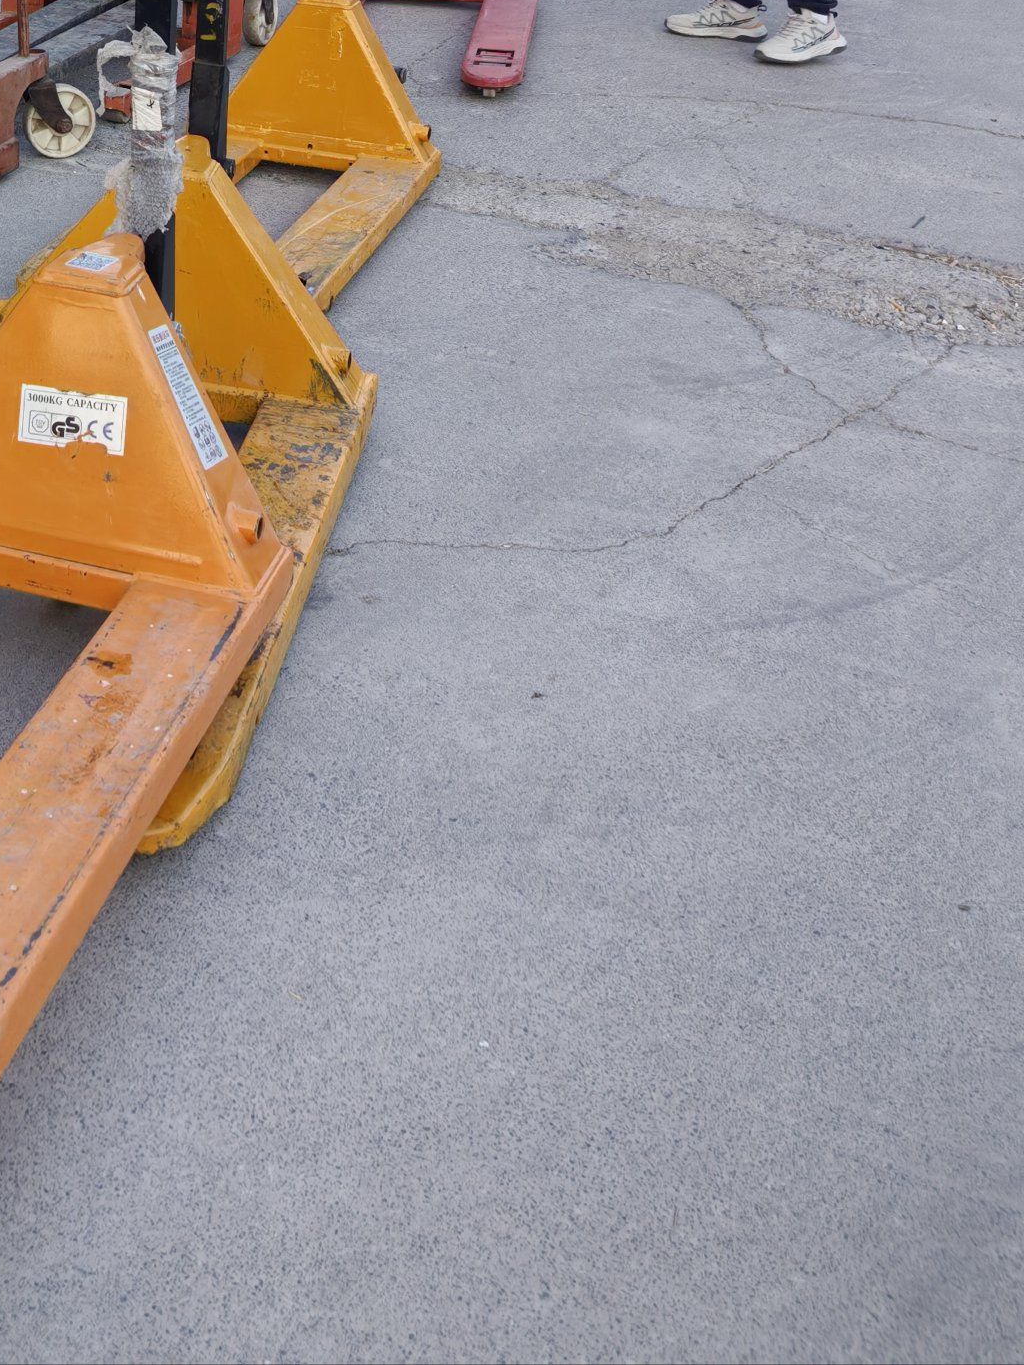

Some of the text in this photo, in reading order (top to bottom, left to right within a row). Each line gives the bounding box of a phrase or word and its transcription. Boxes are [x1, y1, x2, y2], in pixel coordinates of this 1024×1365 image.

[27, 392, 118, 412] 3000KG CAPACITY
[51, 415, 80, 438] GS
